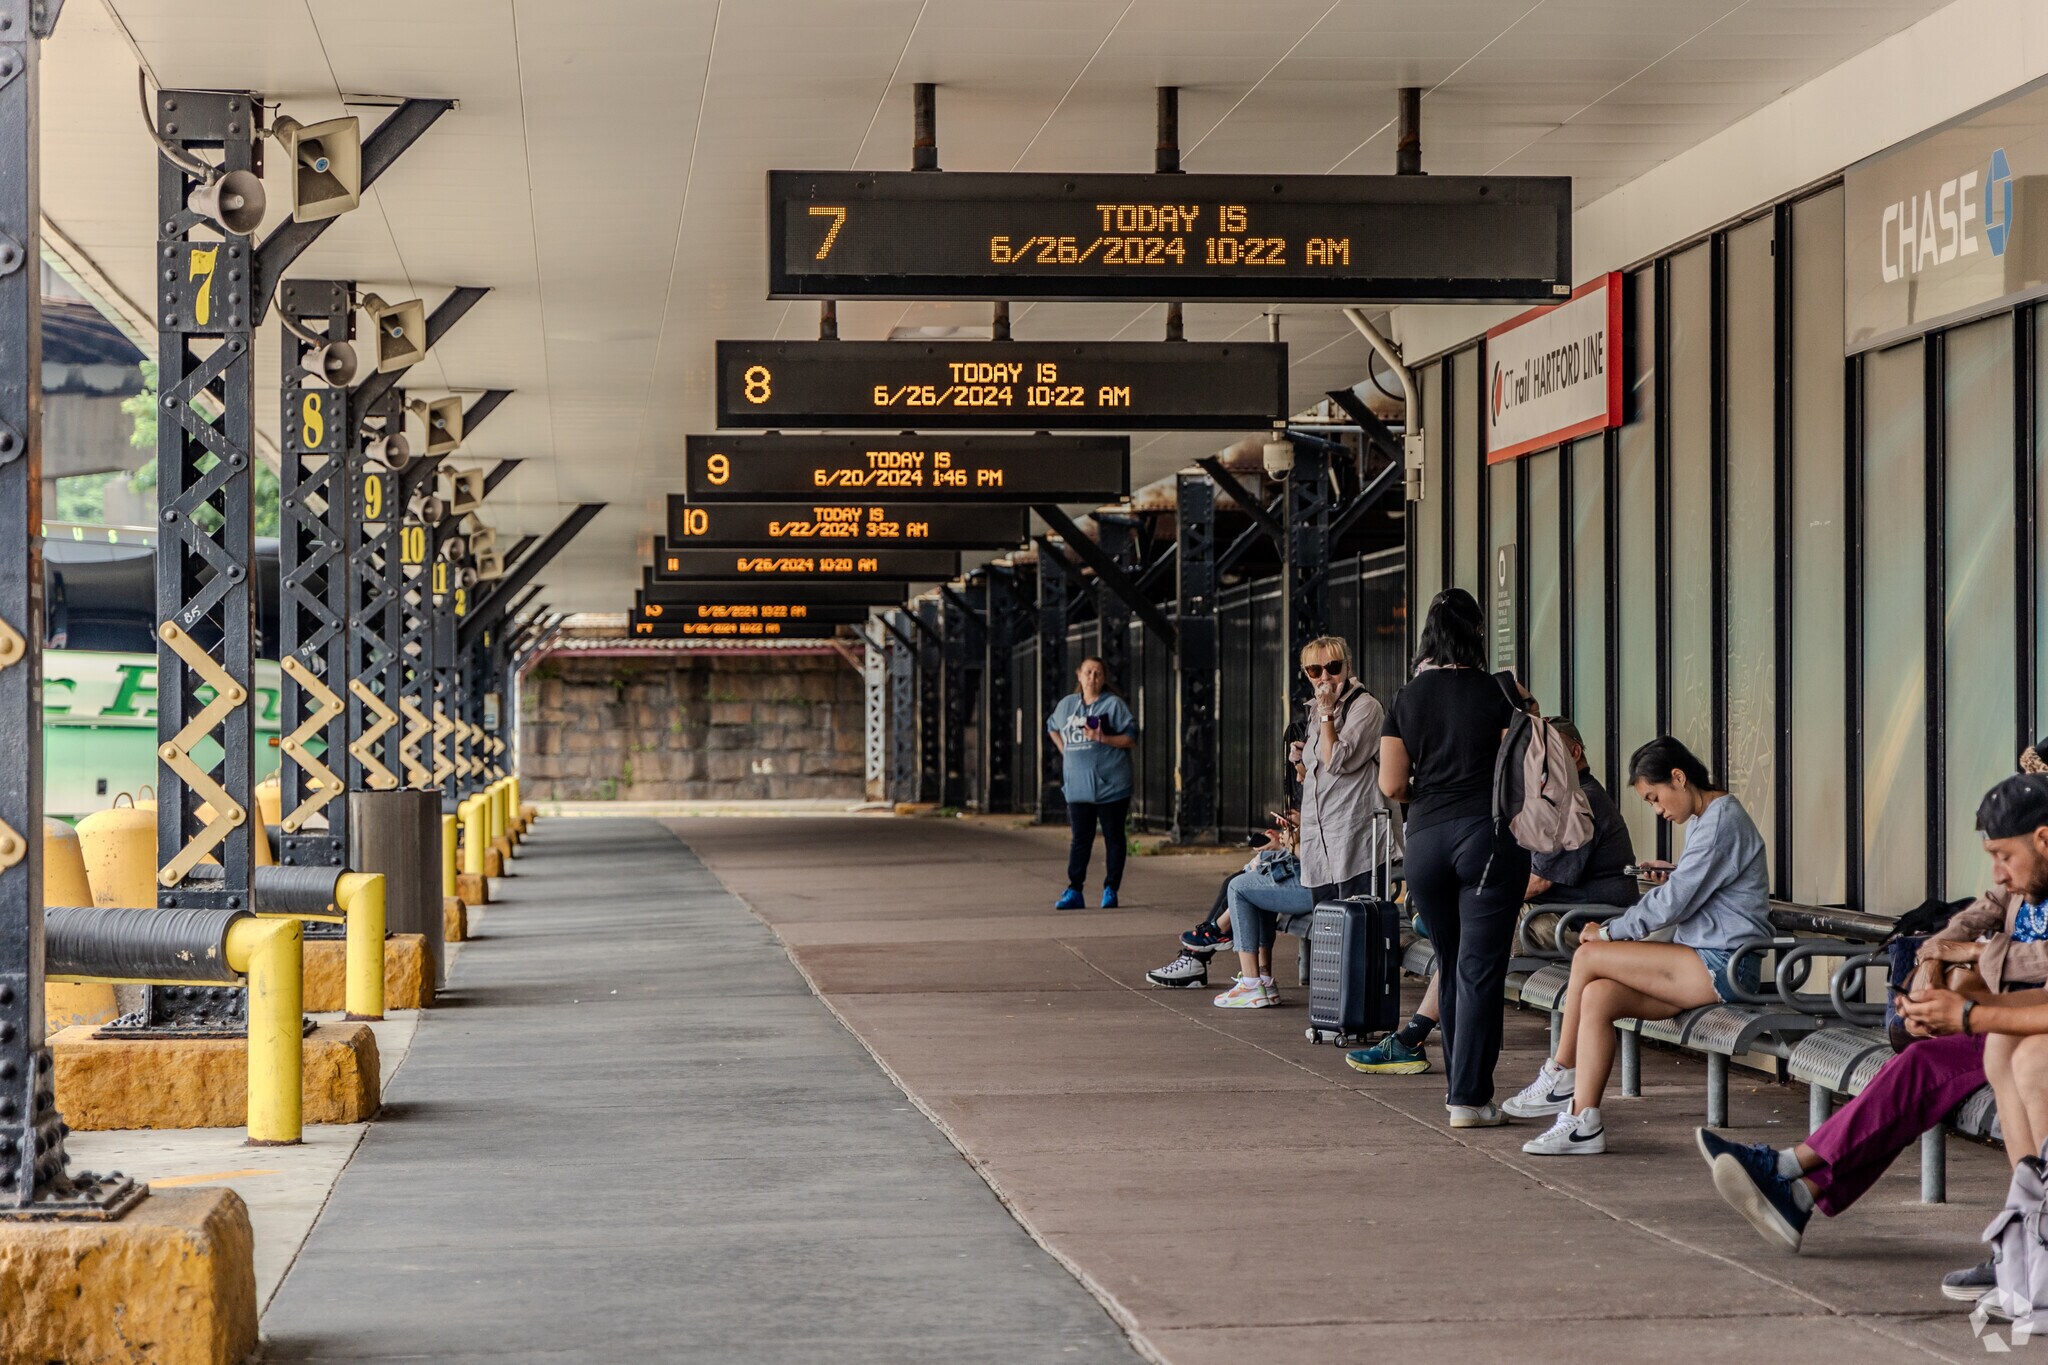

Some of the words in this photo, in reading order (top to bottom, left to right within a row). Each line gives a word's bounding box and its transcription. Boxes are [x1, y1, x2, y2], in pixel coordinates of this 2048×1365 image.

[1096, 204, 1200, 232] TODAY
[1219, 205, 1248, 232] IS
[1882, 170, 1979, 283] CHASE
[808, 206, 847, 260] 7
[990, 236, 1186, 264] 6/26/2024
[1205, 237, 1286, 264] 10:22
[1306, 238, 1350, 264] AM
[189, 246, 219, 326] 7
[948, 362, 1023, 386] TODAY
[1036, 362, 1057, 386] IS
[1533, 341, 1580, 400] HARTFORD
[1583, 330, 1603, 381] LINE
[744, 365, 772, 404] 8
[873, 384, 1013, 408] 6/26/2024
[1027, 384, 1085, 408] 10:22
[1098, 385, 1130, 408] AM
[302, 392, 324, 449] 8
[707, 454, 730, 486] 9
[865, 451, 925, 469] TODAY
[935, 451, 951, 469] IS
[813, 469, 924, 487] 6/20/2024
[932, 469, 968, 487] 1:46
[977, 469, 1003, 487] PM
[364, 475, 382, 520] 9
[683, 508, 709, 536] 10
[768, 520, 860, 538] 6/22/2024
[906, 521, 929, 538] AM
[813, 507, 863, 523] TODAY
[868, 507, 885, 523] IS
[399, 526, 426, 564] 10
[736, 557, 815, 573] 6/26/2024
[857, 557, 878, 572] AM
[454, 588, 467, 617] 2
[790, 605, 807, 618] AM
